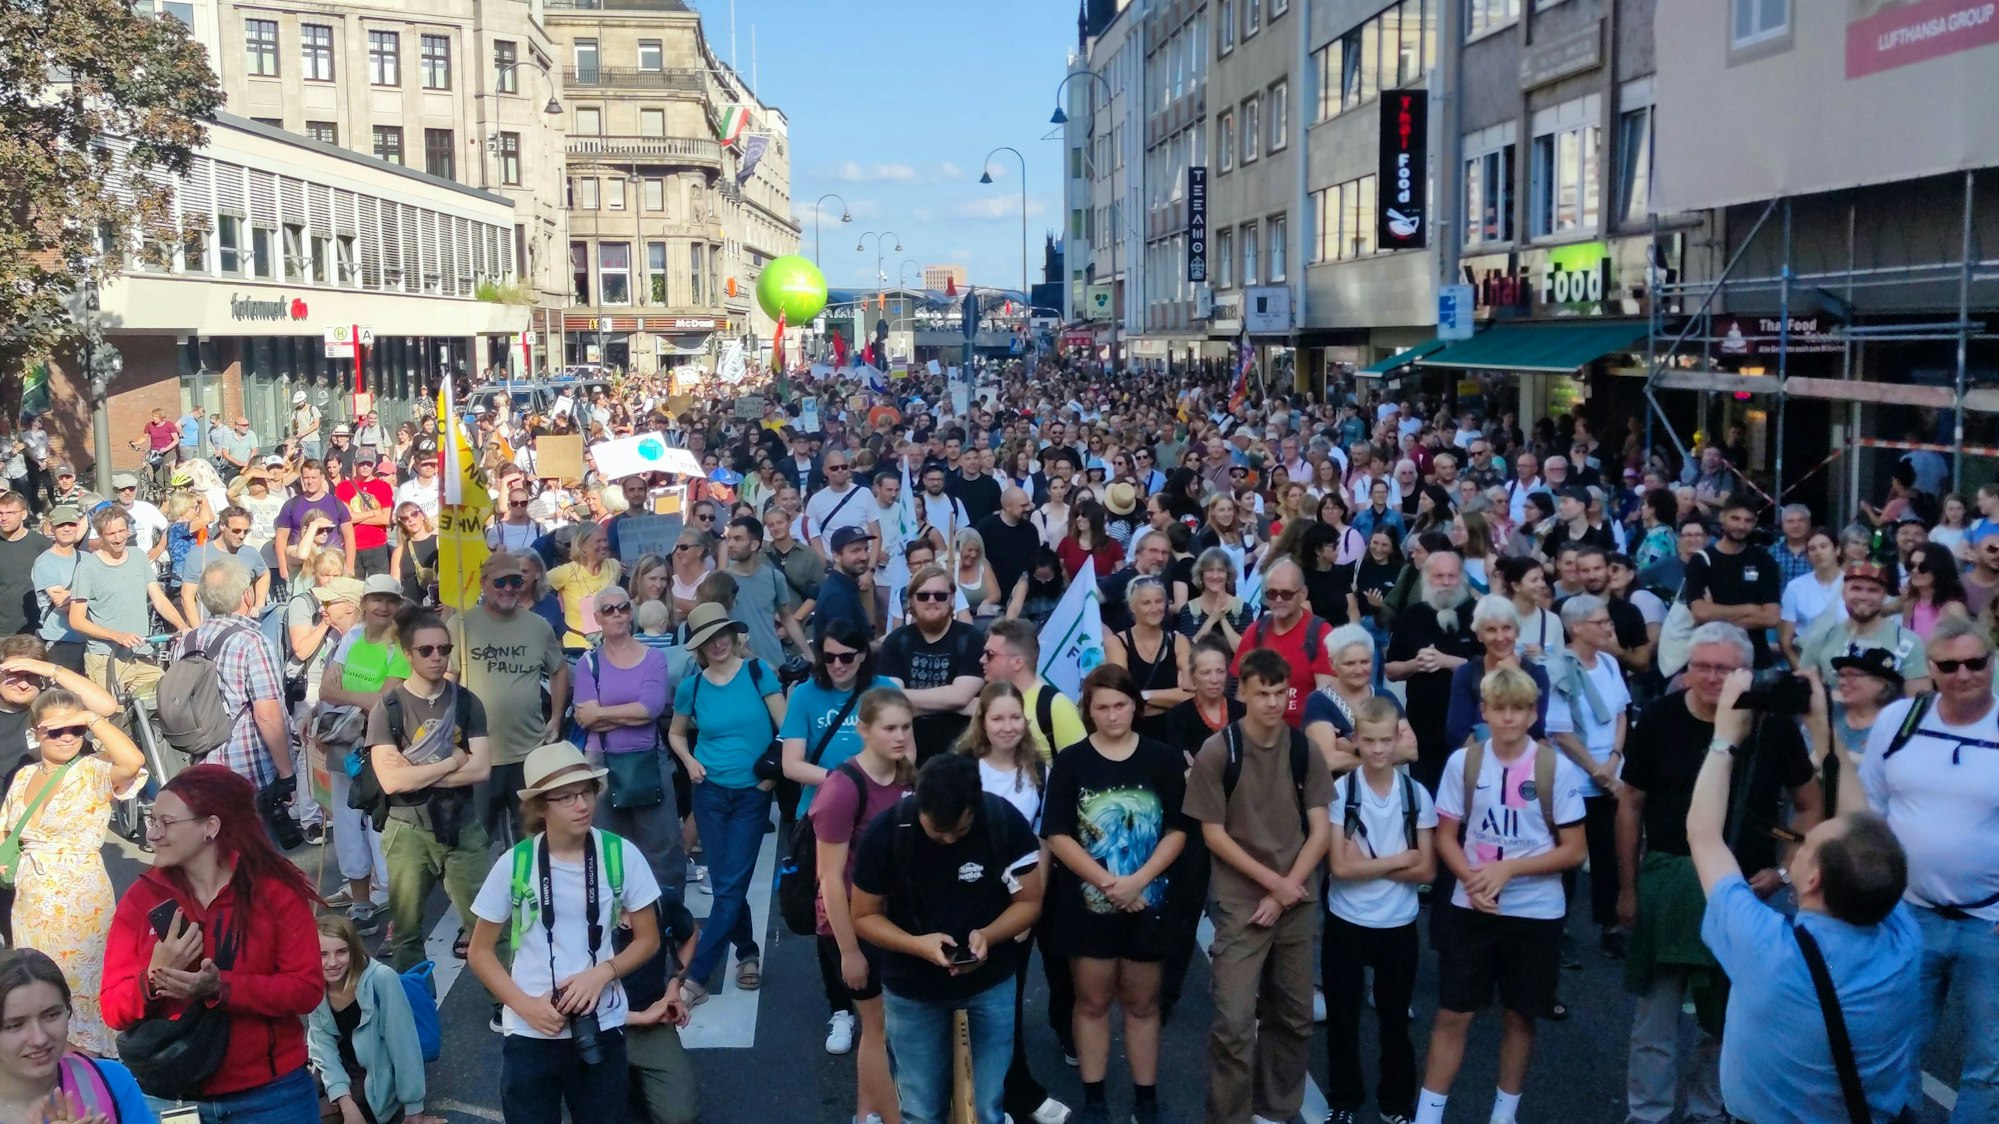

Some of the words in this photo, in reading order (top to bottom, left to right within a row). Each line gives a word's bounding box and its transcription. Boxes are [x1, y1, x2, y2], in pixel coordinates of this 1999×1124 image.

[1878, 17, 1946, 51] LUFTHANSA
[1949, 3, 1995, 32] GROUP
[1397, 153, 1411, 204] Food
[1541, 258, 1603, 304] Food
[363, 330, 371, 341] A
[1760, 319, 1786, 331] Tha
[1788, 318, 1817, 331] Food
[470, 643, 528, 661] SANKT
